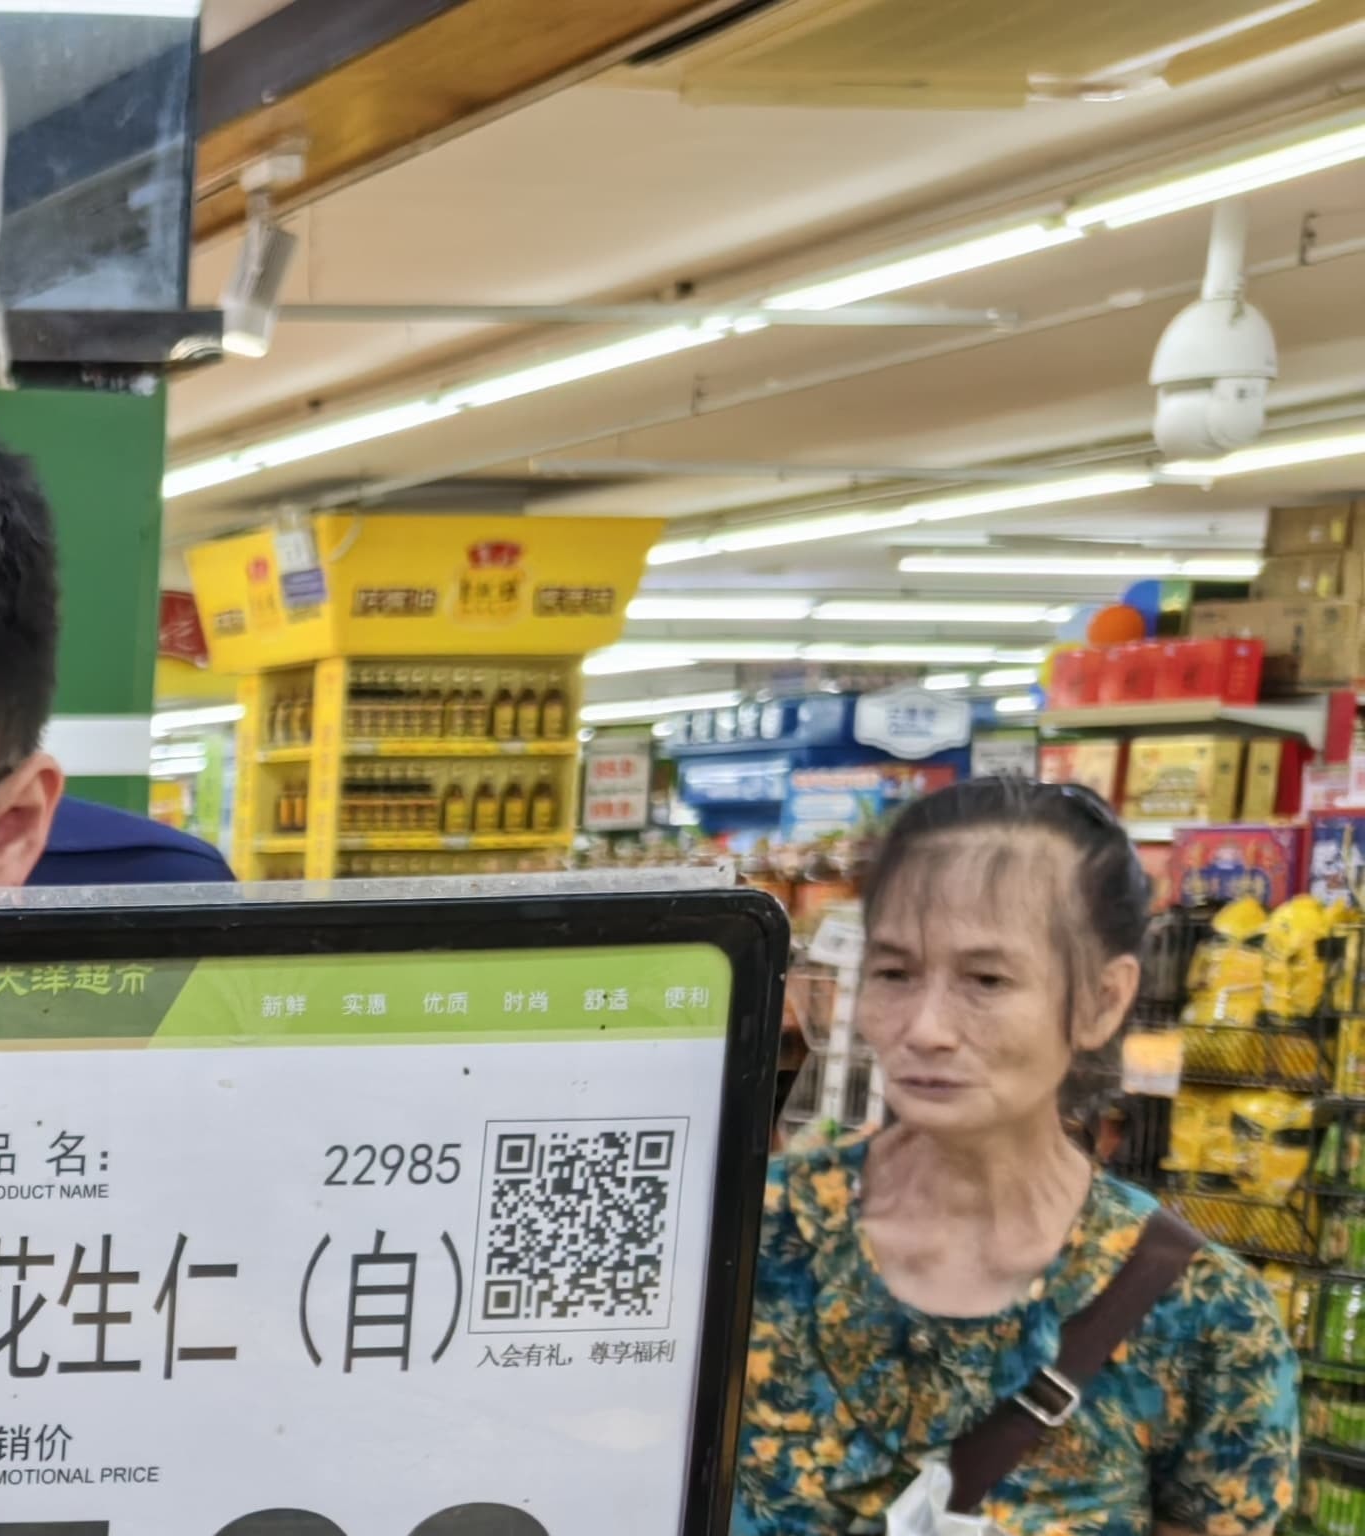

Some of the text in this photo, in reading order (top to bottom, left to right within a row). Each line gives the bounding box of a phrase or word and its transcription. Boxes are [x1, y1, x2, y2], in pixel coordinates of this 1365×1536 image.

[261, 987, 709, 1018] 新鲜 实惠 优质 时尚 舒适 便利
[324, 1142, 463, 1187] 22985
[60, 1184, 109, 1199] NAME
[100, 1466, 161, 1483] PRICE
